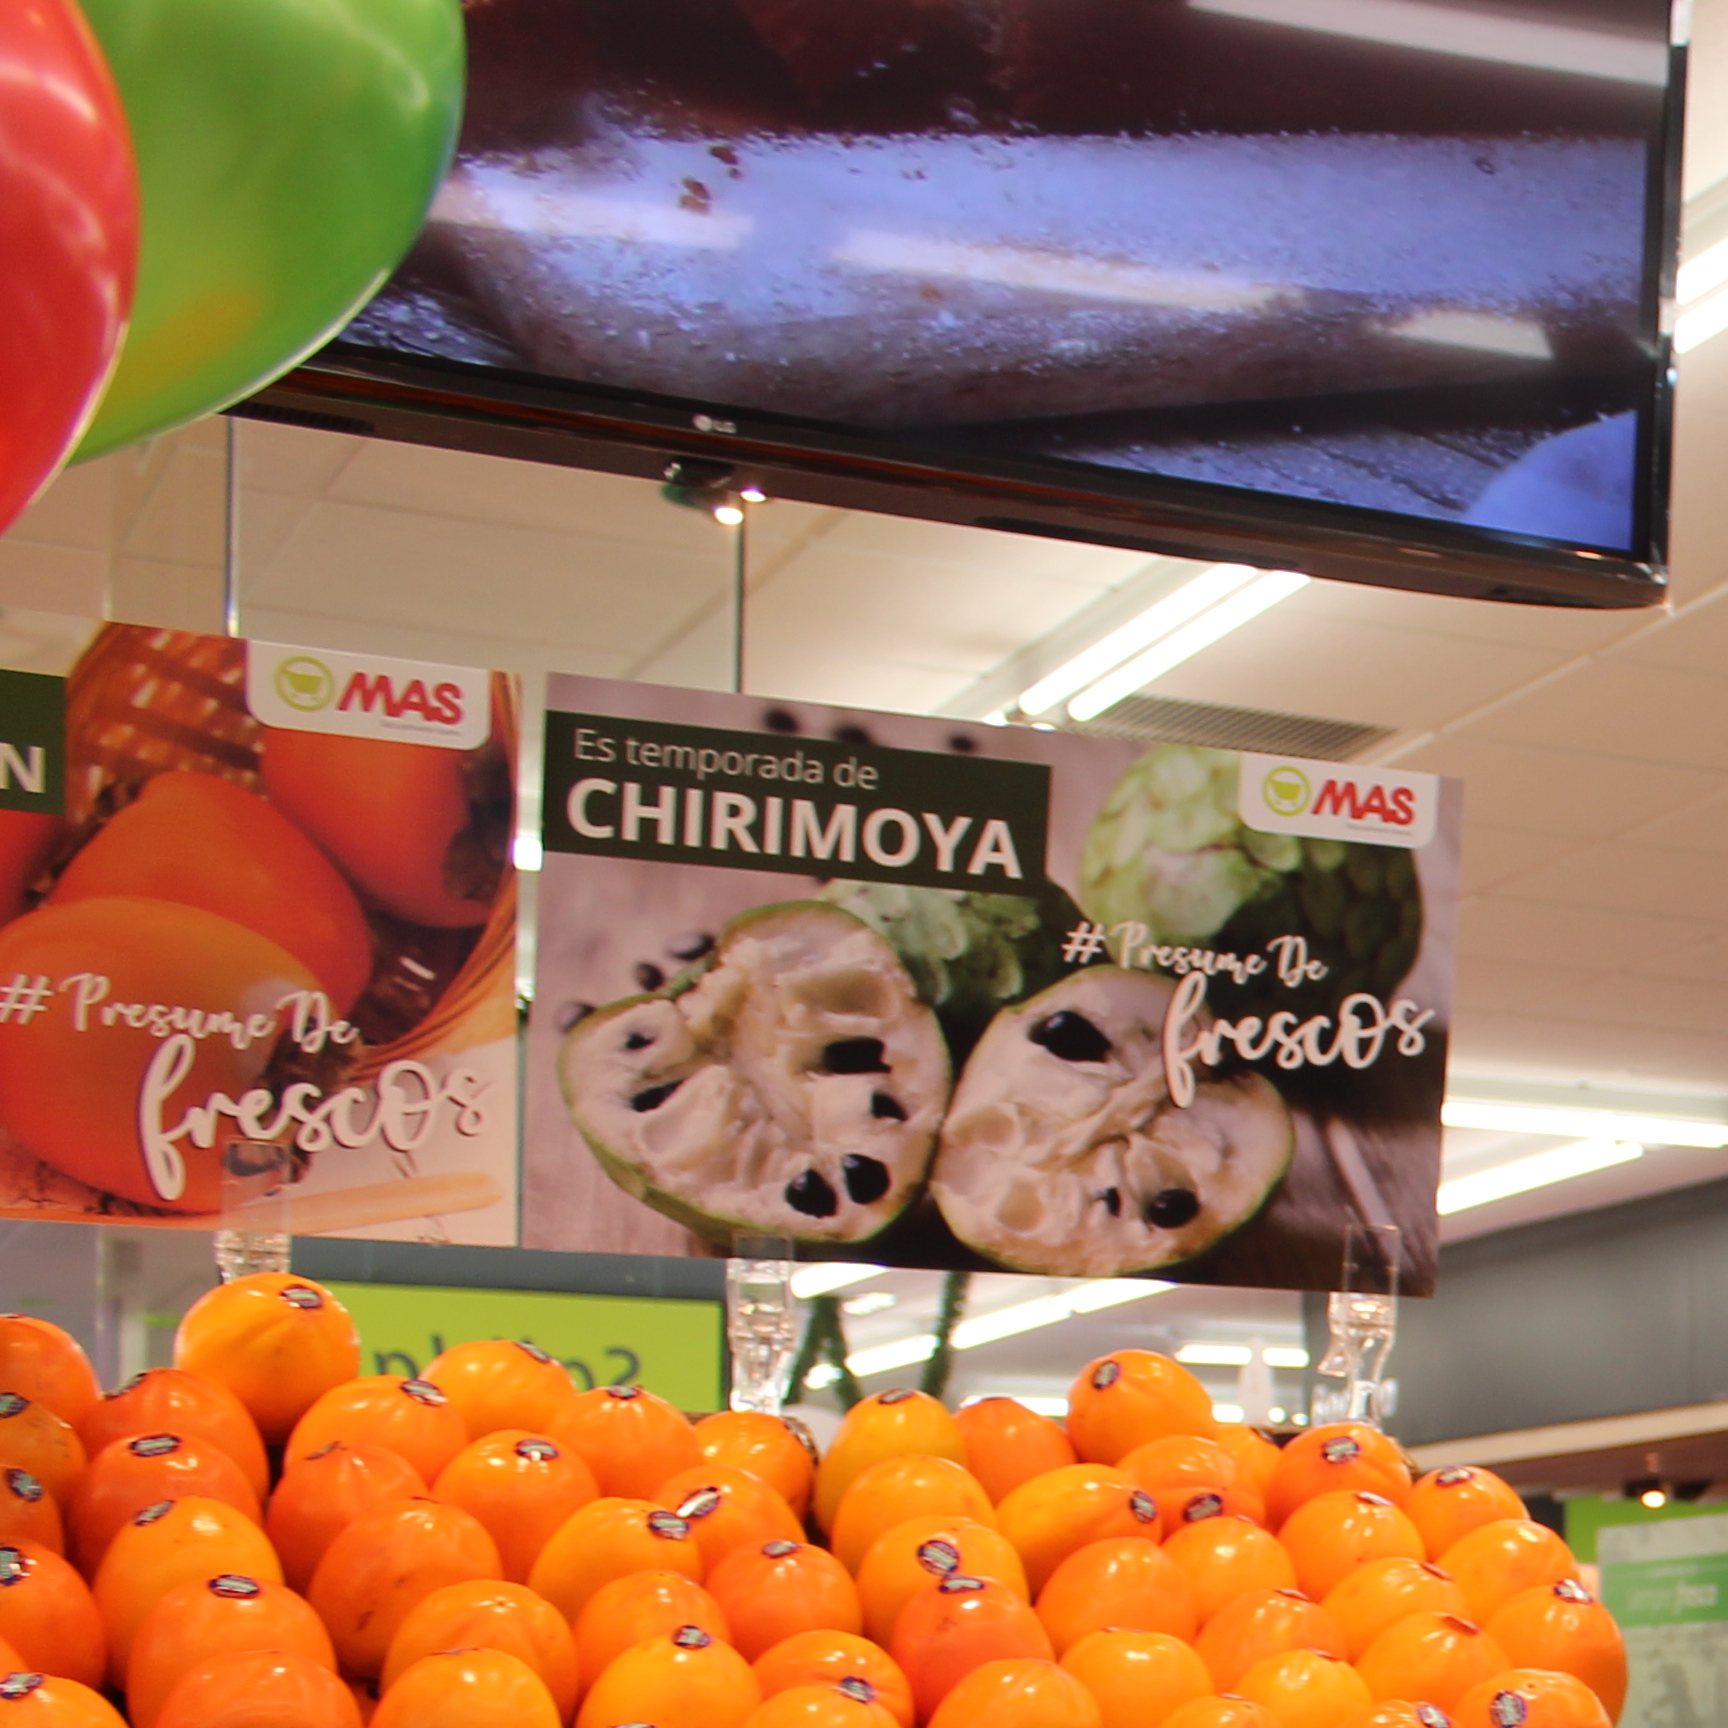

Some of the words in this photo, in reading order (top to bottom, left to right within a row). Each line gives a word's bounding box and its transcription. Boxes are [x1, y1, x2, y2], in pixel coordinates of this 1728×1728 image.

[338, 671, 464, 726] MAS
[573, 727, 617, 764] Es
[625, 732, 823, 789] temporada
[834, 757, 880, 792] de
[566, 777, 1023, 880] CHIRIMOYA
[1310, 779, 1416, 828] MAS
